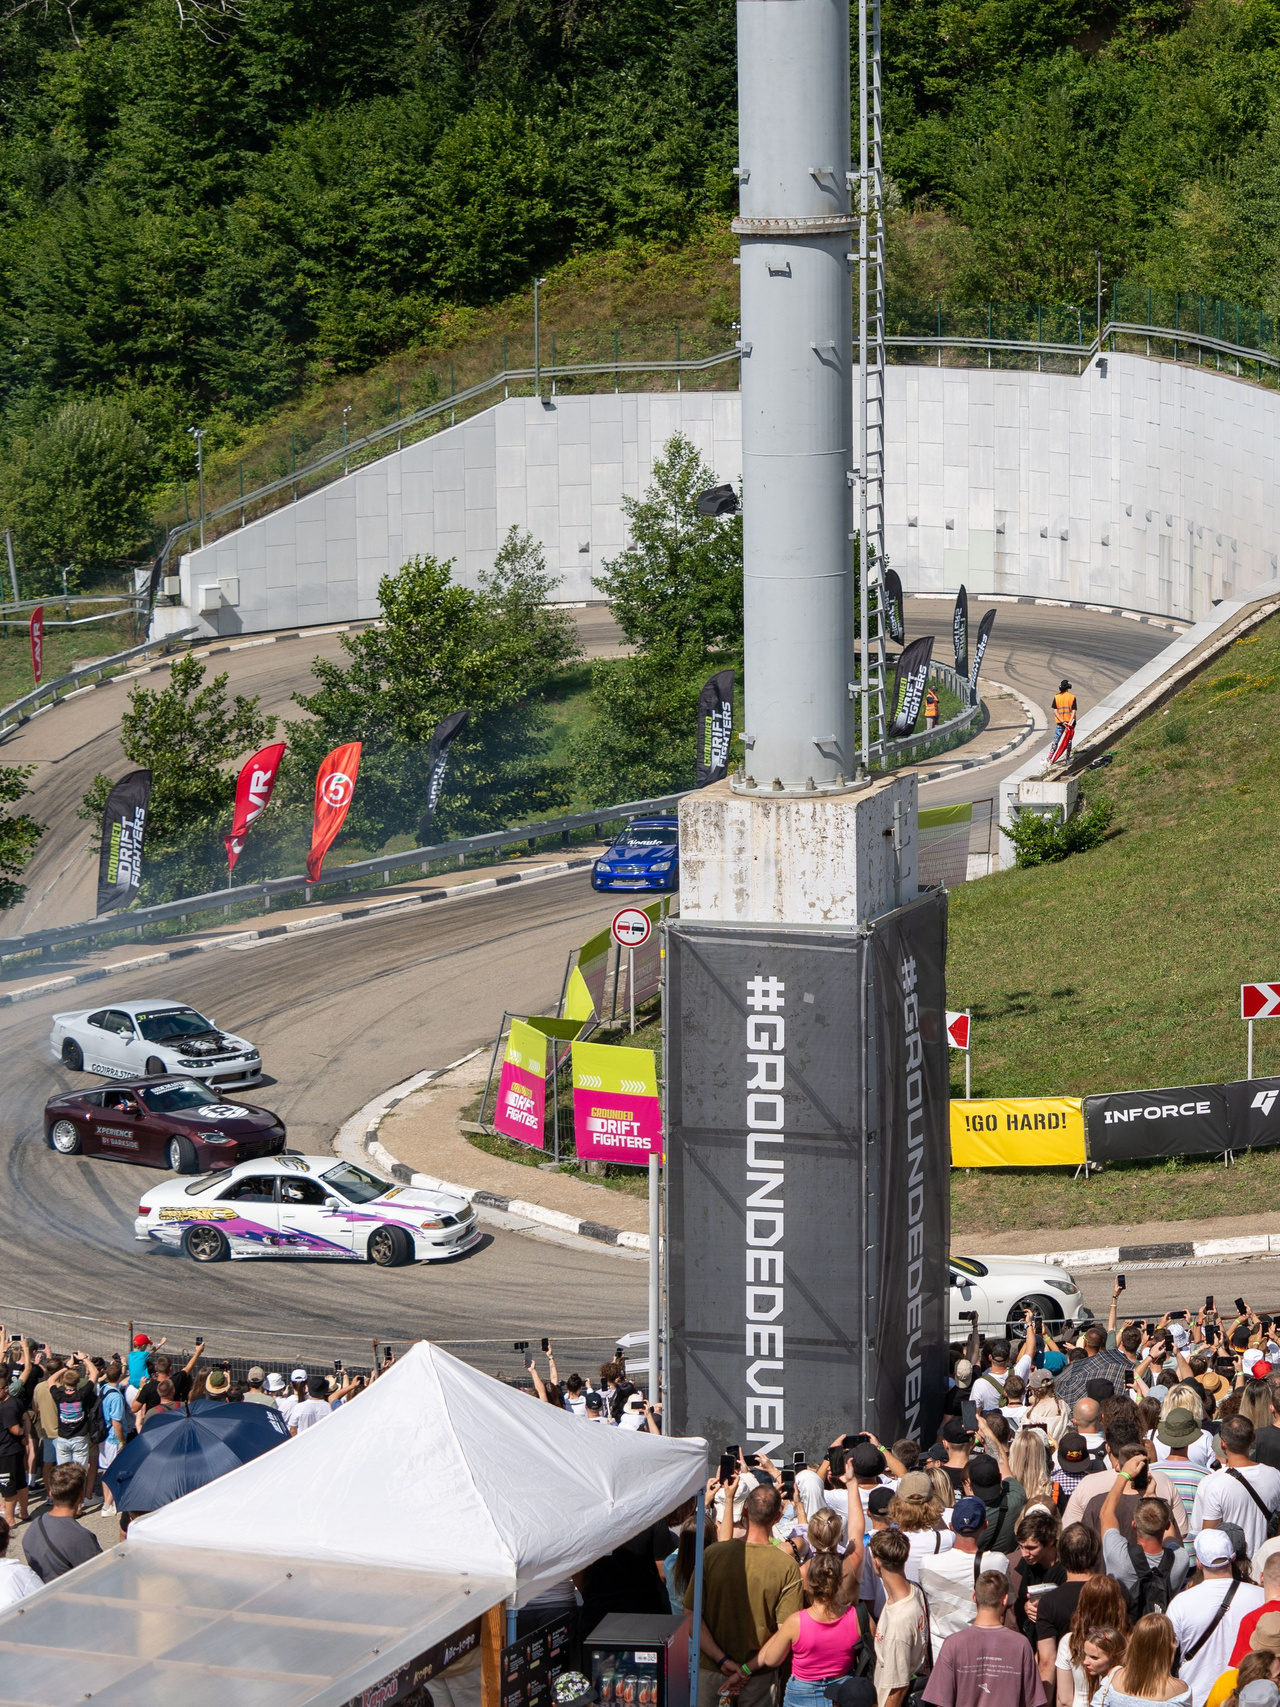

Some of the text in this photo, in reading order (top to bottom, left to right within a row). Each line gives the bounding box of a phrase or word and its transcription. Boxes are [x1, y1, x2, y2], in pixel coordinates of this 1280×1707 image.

[34, 622, 42, 676] LAVR
[894, 677, 908, 722] GROUNDED
[898, 672, 917, 722] DRIFT
[907, 664, 927, 725] FIGHTERS
[704, 716, 713, 767] GROUNDED
[711, 710, 723, 768] DRIFT
[717, 701, 732, 768] FIGHTERS
[107, 822, 122, 884] GROUNDED
[117, 816, 134, 886] DRIFT
[131, 806, 145, 888] FIGHTERS
[506, 1106, 538, 1130] FIGHTERS
[508, 1091, 535, 1114] DRIFT
[591, 1107, 634, 1121] GROUNDED
[964, 1111, 1067, 1134] !GO HARD!
[1104, 1101, 1211, 1125] INFORCE
[97, 1126, 133, 1138] XPERIENCE
[110, 1139, 138, 1149] DARKSIDE
[593, 1117, 640, 1136] DRIFT
[593, 1132, 651, 1149] FIGHTERS
